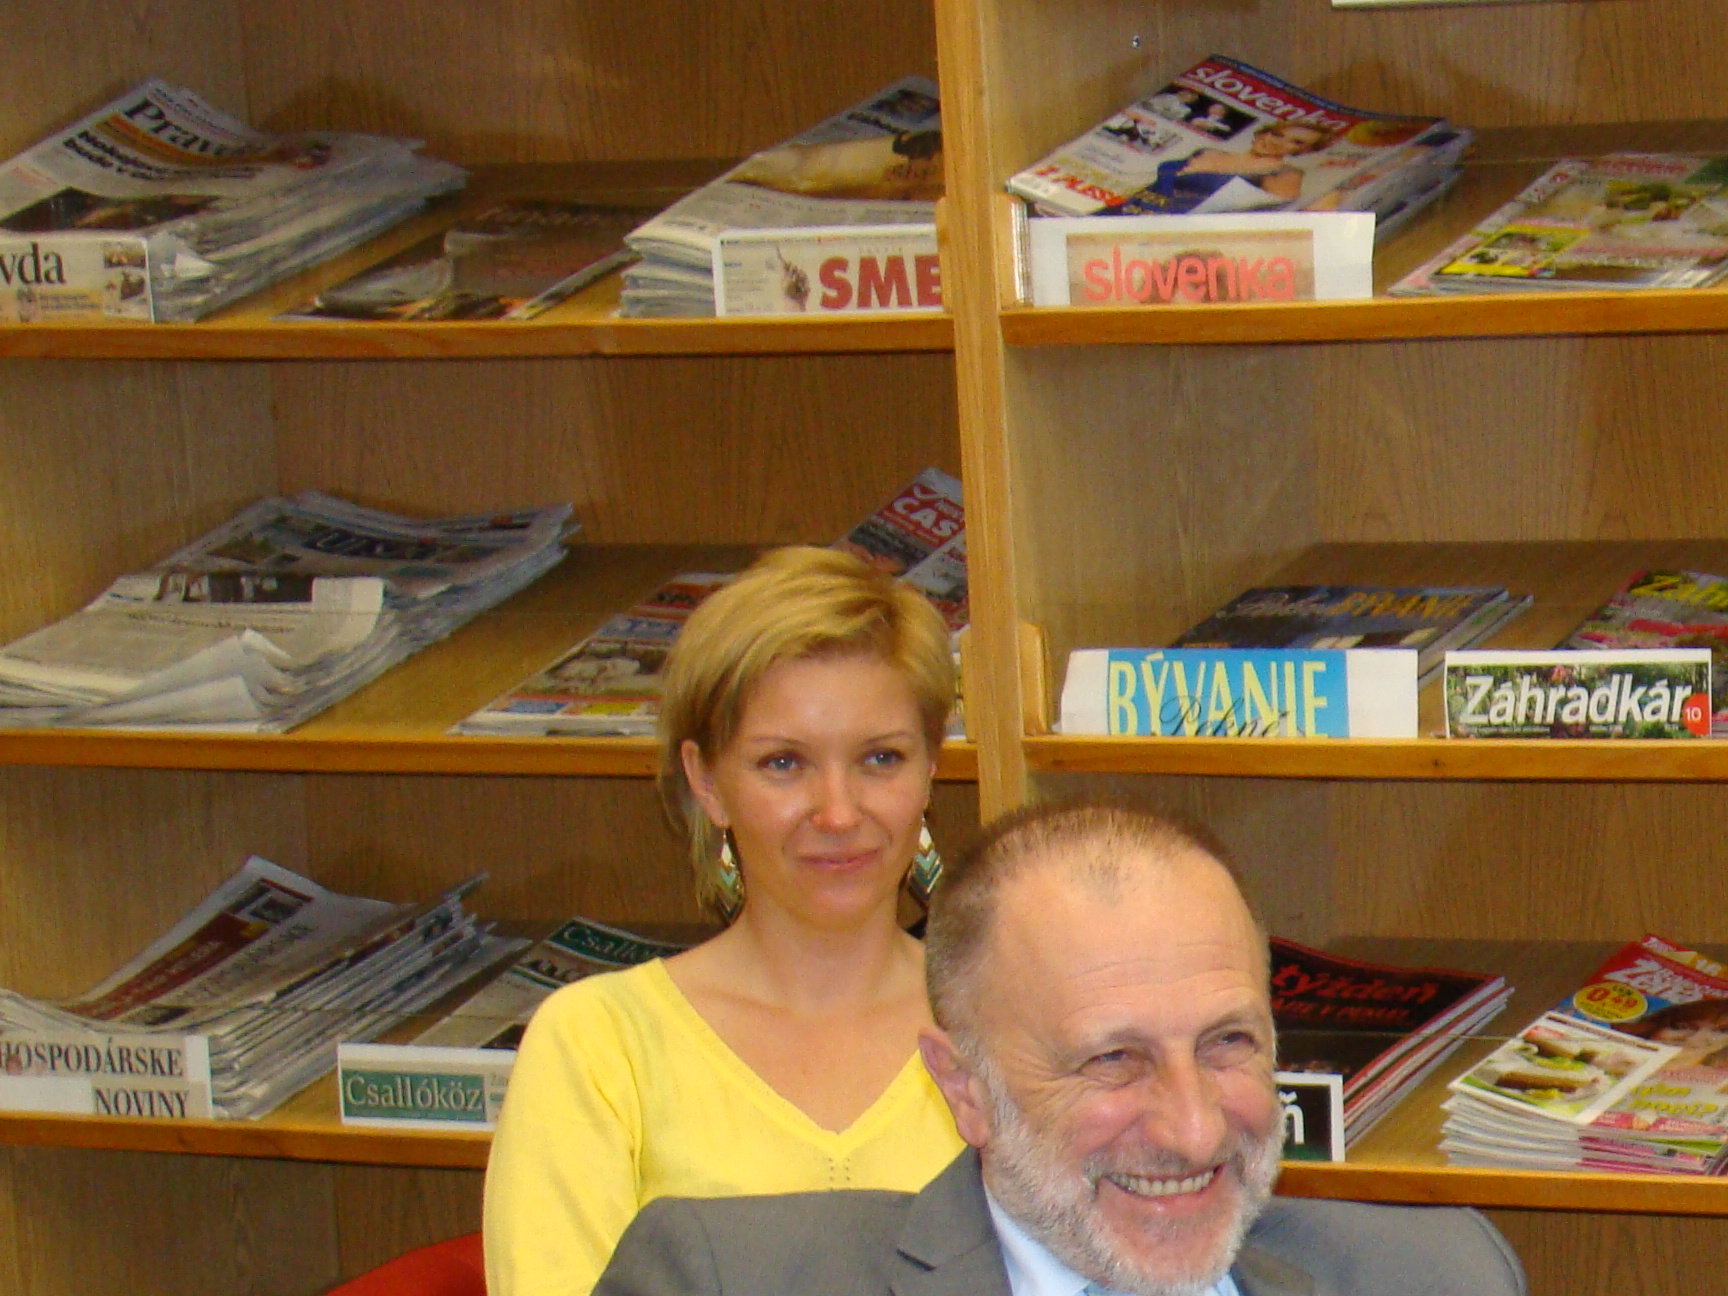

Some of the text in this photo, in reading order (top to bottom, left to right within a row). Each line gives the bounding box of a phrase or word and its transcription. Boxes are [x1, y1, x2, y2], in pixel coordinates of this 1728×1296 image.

[1195, 67, 1348, 130] slovenka
[819, 255, 942, 309] SME
[1083, 244, 1296, 301] slovenka
[1108, 652, 1330, 738] BÝVANIE
[1459, 673, 1702, 726] Záhradkár 10
[93, 1087, 189, 1119] NOVINY
[345, 1075, 483, 1112] Csallóköz
